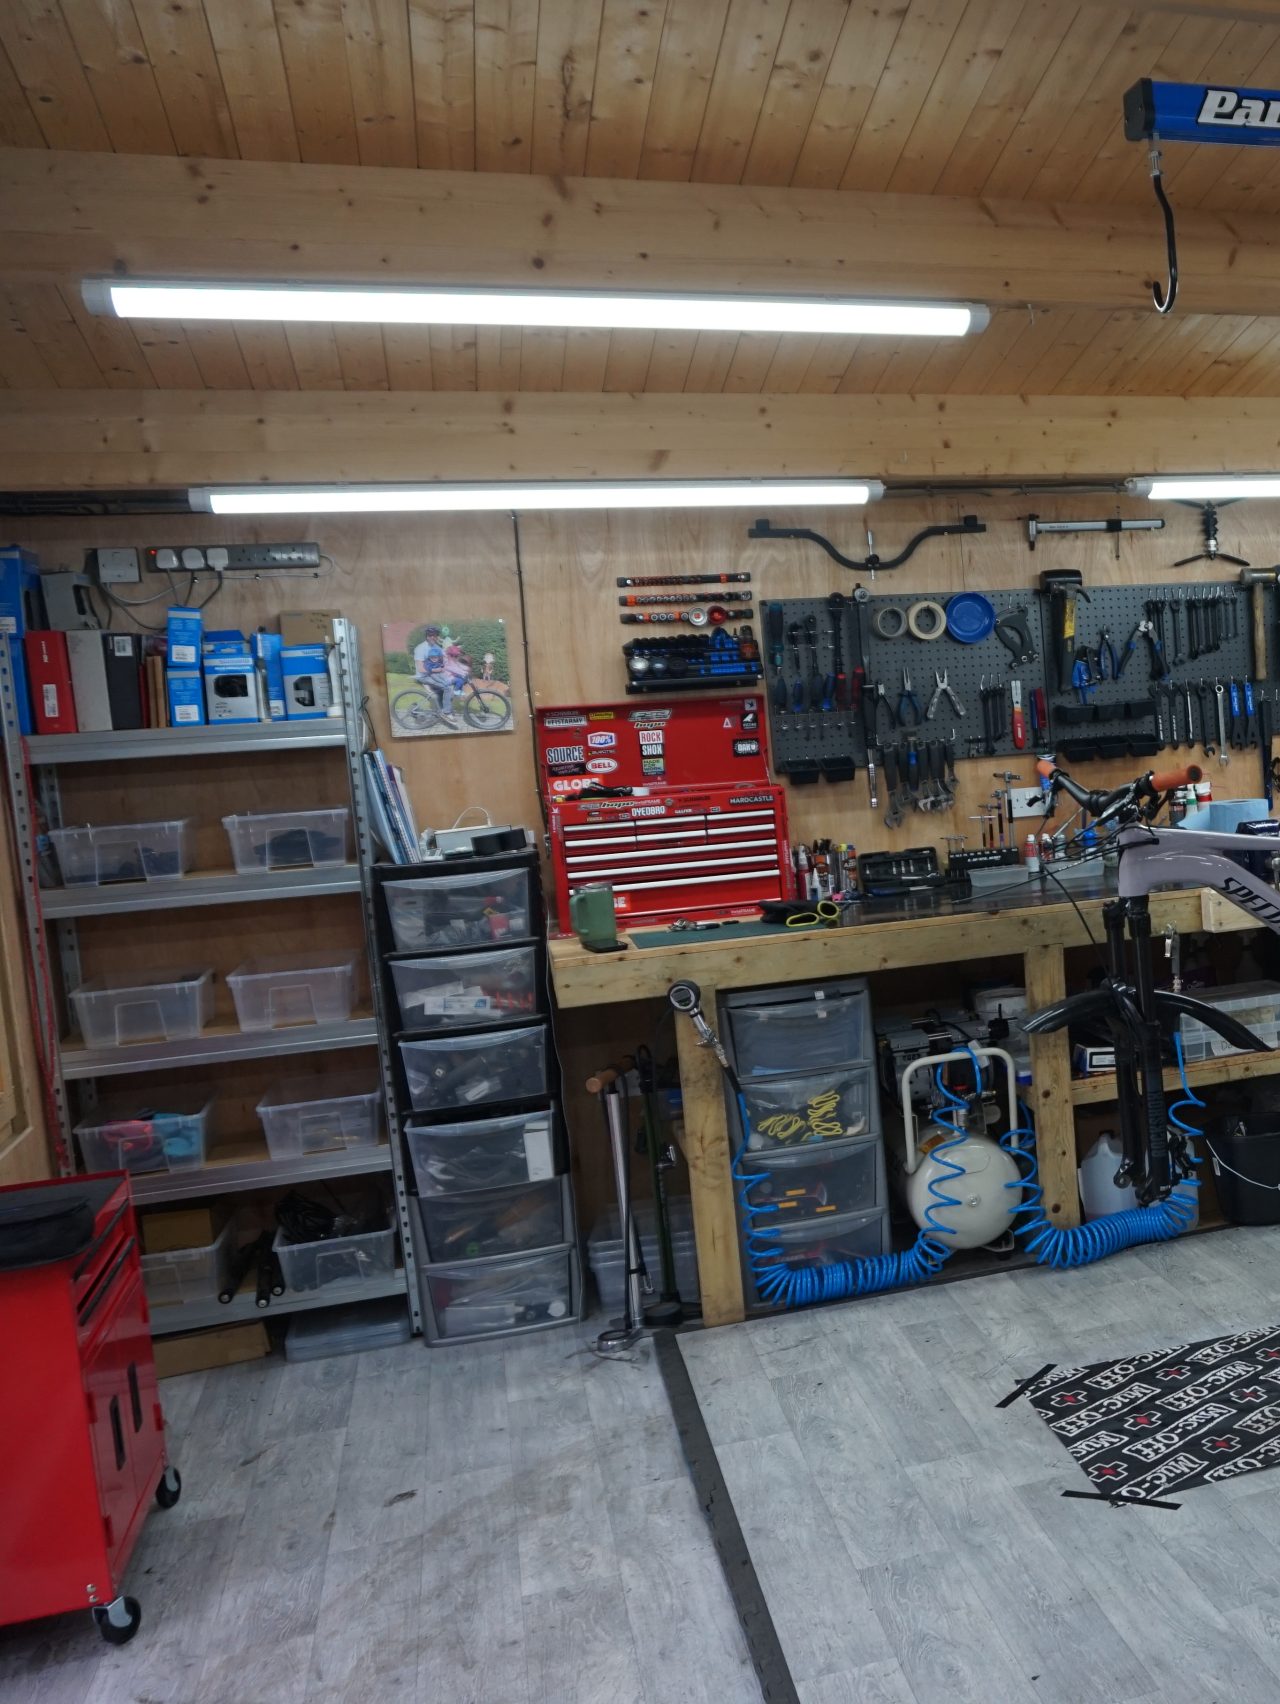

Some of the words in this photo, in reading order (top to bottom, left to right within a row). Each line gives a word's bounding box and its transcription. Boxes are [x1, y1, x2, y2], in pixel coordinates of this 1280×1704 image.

[640, 731, 662, 743] ROCK
[546, 746, 585, 765] SOURCE
[641, 744, 663, 756] SHOX
[591, 761, 613, 770] BELL
[1055, 1384, 1154, 1435] Muc-Off
[1131, 1404, 1230, 1460] Muc-Off
